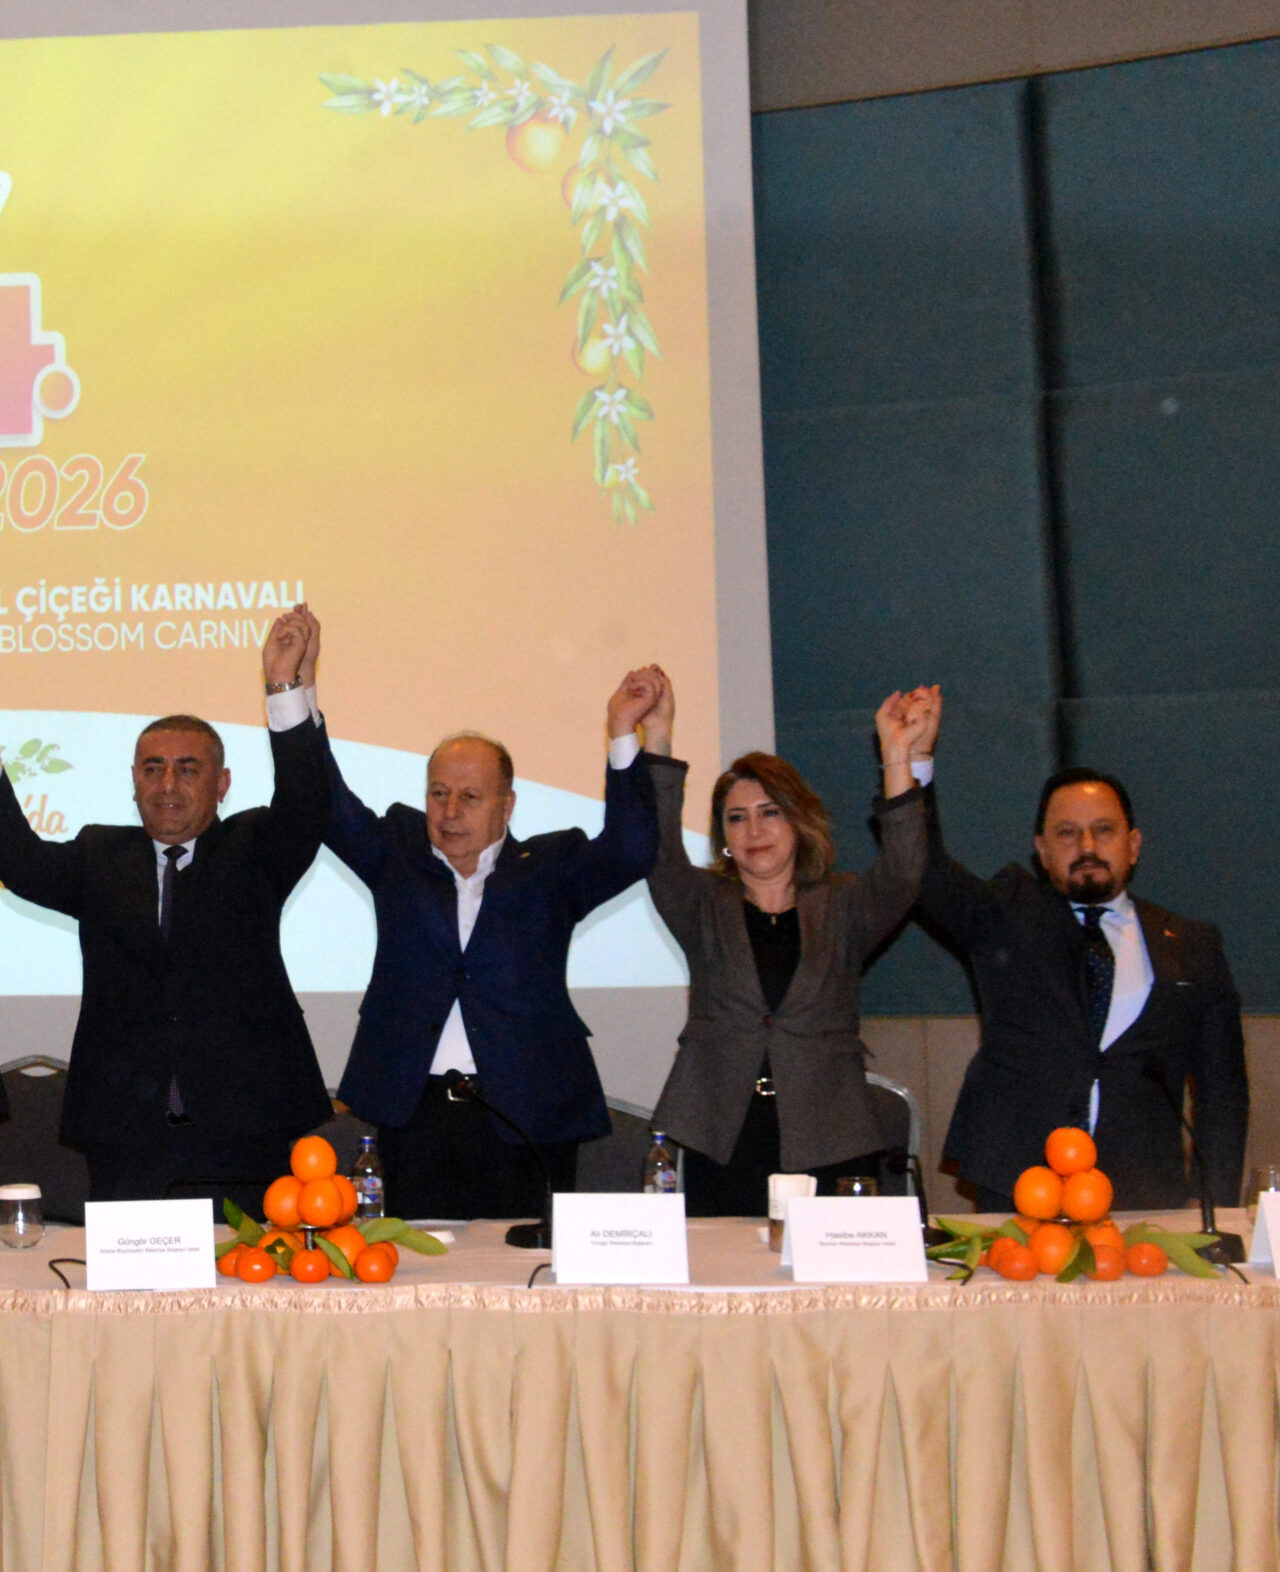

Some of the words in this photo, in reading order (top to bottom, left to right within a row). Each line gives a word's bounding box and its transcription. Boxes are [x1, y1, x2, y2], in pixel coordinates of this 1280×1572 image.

[15, 578, 121, 623] ÇİÇEĞİ
[130, 580, 304, 613] KARNAVALI
[154, 617, 271, 650] CARNIV
[149, 1236, 181, 1247] GEÇER
